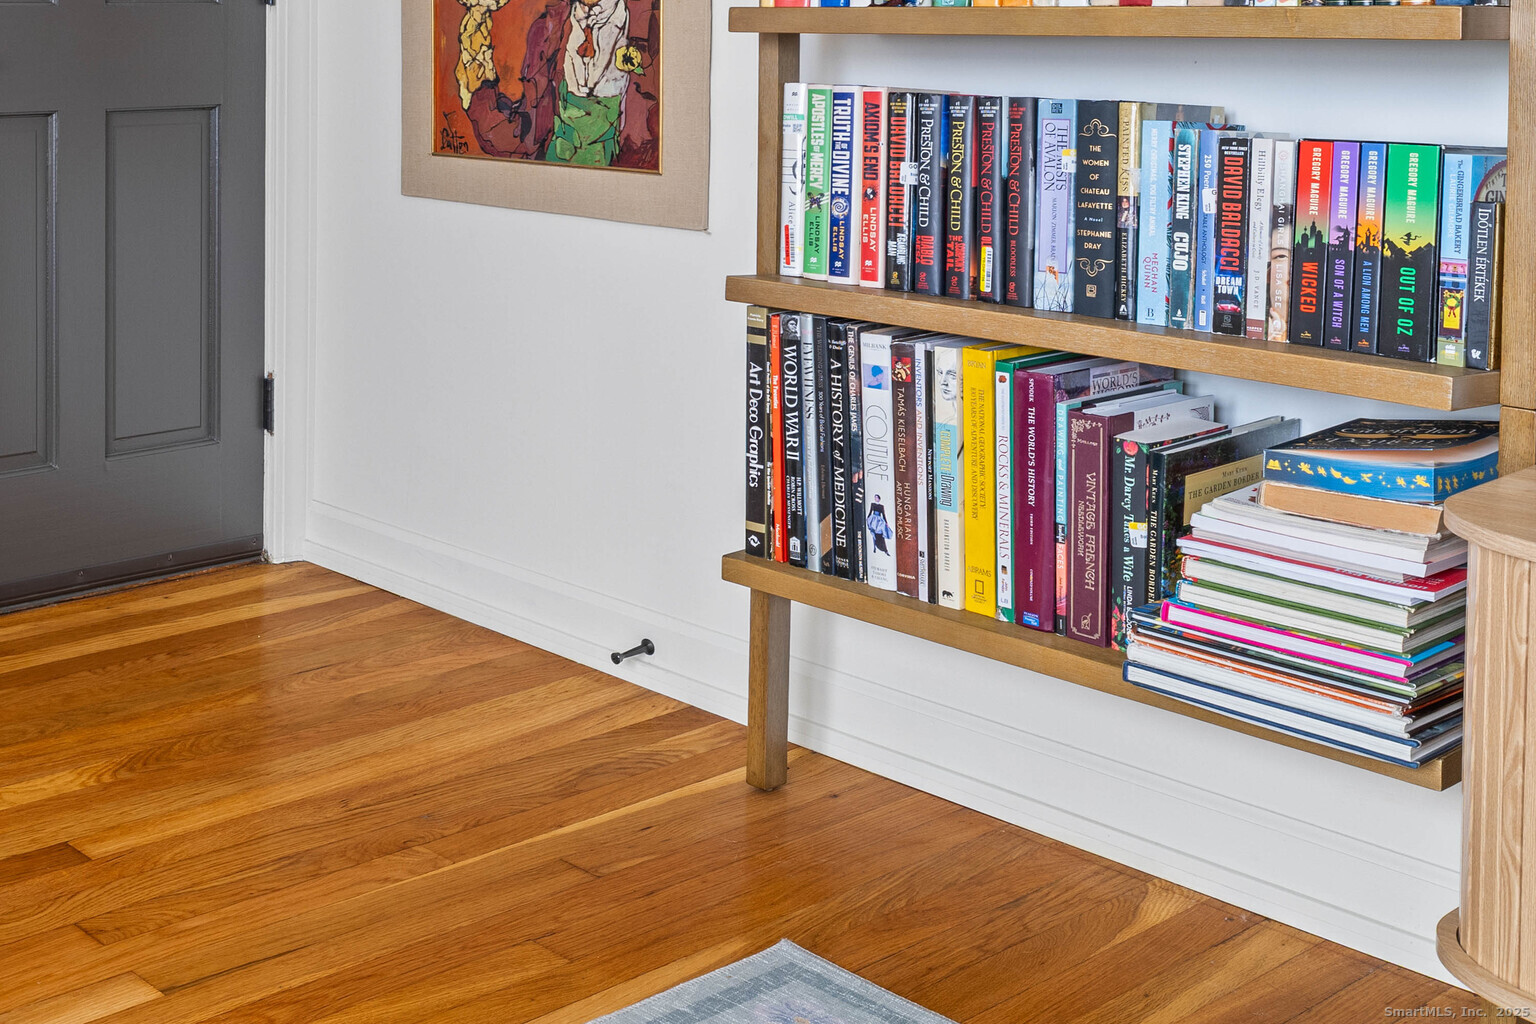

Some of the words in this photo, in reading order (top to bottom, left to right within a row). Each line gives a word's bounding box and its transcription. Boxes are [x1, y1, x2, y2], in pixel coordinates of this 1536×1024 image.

[833, 98, 851, 141] TRUTH
[1045, 122, 1055, 138] OF
[1082, 159, 1110, 167] WOMEN
[1089, 145, 1102, 153] THE
[1204, 154, 1212, 168] 250
[1311, 147, 1322, 180] GREGORY
[832, 150, 850, 194] DIVINE
[1044, 140, 1055, 192] AVALON
[1177, 144, 1191, 193] STEPHEN
[1223, 157, 1244, 199] DAVID
[1339, 150, 1350, 184] GREGORY
[1367, 150, 1379, 185] GREGORY
[1408, 152, 1419, 187] GREGORY
[1077, 202, 1113, 210] LAFAYETTE
[1080, 187, 1110, 195] CHATEAU
[1176, 193, 1189, 220] KING
[1309, 180, 1320, 215] MAGUIRE
[1337, 186, 1348, 219] MAGUIRE
[1365, 186, 1377, 220] MAGUIRE
[1405, 189, 1417, 223] MAGUIRE
[869, 207, 877, 252] LINDSAY
[1077, 230, 1112, 239] STEPHANIE
[1084, 242, 1102, 250] DRAY
[1220, 202, 1242, 271] BALDACCI
[920, 235, 934, 265] DIABLO
[946, 241, 954, 271] TAIL
[1173, 232, 1189, 271] CUJO
[1143, 256, 1151, 288] QUINN
[1151, 252, 1159, 294] MEGHAN
[1333, 278, 1344, 290] OF
[1334, 259, 1345, 276] SON
[1362, 268, 1372, 285] LION
[1399, 267, 1416, 293] OUT
[1300, 262, 1319, 313] WICKED
[1360, 287, 1371, 314] AMONG
[1331, 299, 1343, 328] WITCH
[1398, 297, 1414, 313] OF
[1359, 316, 1369, 333] MEN
[1396, 319, 1413, 336] OZ
[749, 361, 762, 385] Art
[830, 358, 841, 370] A
[848, 344, 856, 369] GENIUS
[783, 344, 798, 407] WORLD
[849, 371, 856, 381] OF
[915, 357, 923, 407] INVENTORS
[749, 388, 762, 422] Deco
[830, 375, 843, 447] HISTORY
[849, 382, 857, 410] CHARLES
[897, 387, 907, 418] TAMÁS
[784, 411, 799, 448] WAR
[1027, 406, 1035, 424] THE
[746, 425, 763, 488] Graphics
[786, 449, 799, 461] II
[833, 450, 844, 460] of
[865, 405, 889, 481] COUTURE
[897, 418, 907, 472] KIESELBACH
[916, 432, 924, 486] INVENTIONS
[998, 434, 1009, 479] ROCKS
[1027, 426, 1036, 466] WORLD'S
[998, 481, 1009, 492] &
[1027, 468, 1036, 507] HISTORY
[1084, 472, 1096, 530] VINTAGE
[1188, 488, 1202, 499] THE
[1204, 480, 1232, 495] GARDEN
[1234, 472, 1260, 487] BORDER
[834, 466, 846, 547] MEDICINE
[903, 482, 912, 541] HUNGARIAN
[998, 495, 1010, 559] MINERALS
[967, 565, 992, 578] ABRAMS
[1084, 533, 1096, 590] FRENCH
